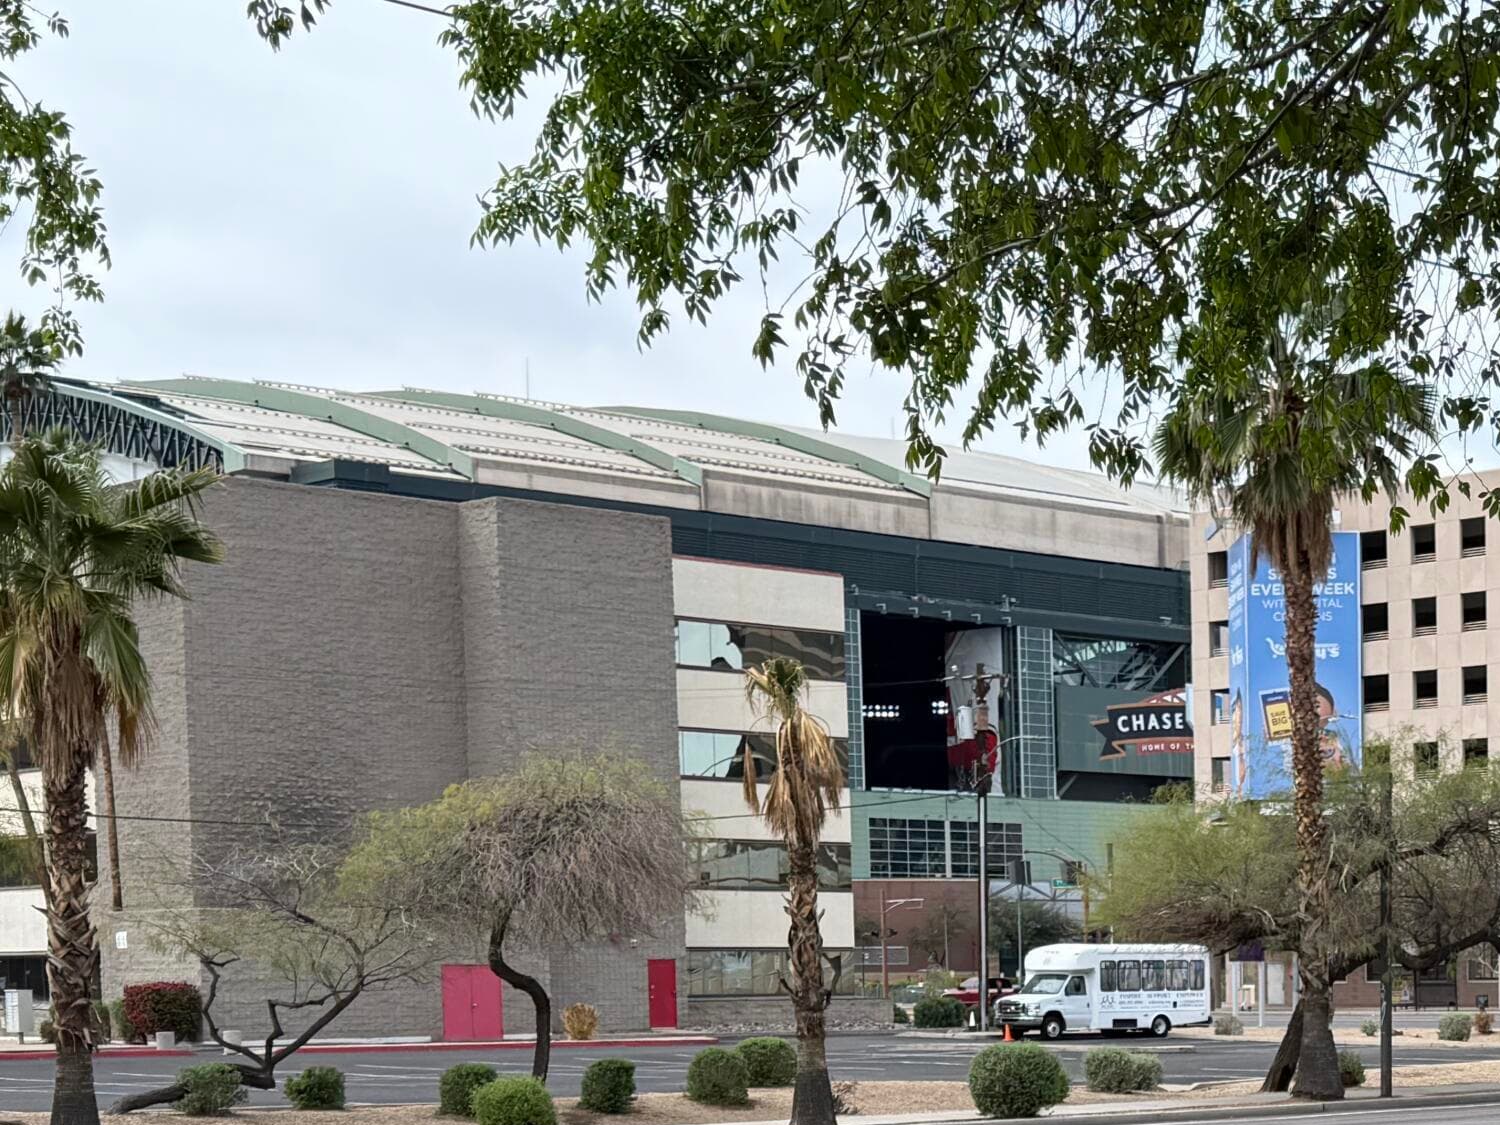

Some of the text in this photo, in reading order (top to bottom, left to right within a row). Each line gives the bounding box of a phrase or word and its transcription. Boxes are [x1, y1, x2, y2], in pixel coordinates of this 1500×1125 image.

[1251, 583, 1285, 596] EVE
[1262, 599, 1285, 609] WIT
[1117, 712, 1184, 733] CHASE
[1141, 743, 1165, 752] HOME
[1169, 743, 1180, 751] OF
